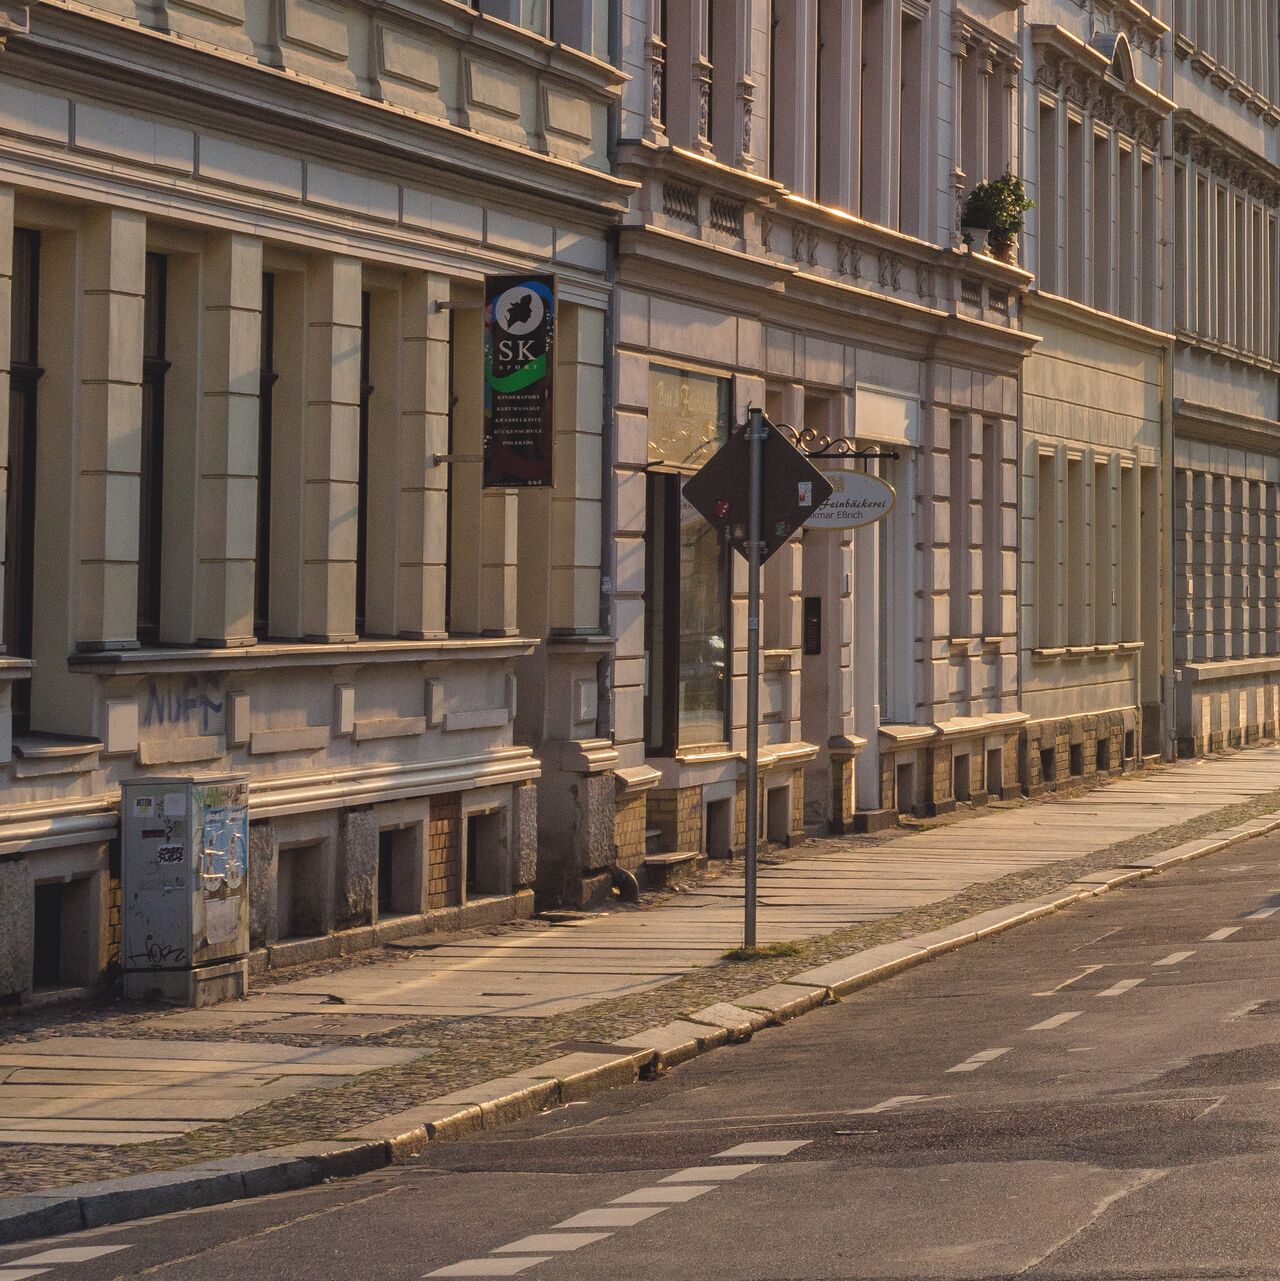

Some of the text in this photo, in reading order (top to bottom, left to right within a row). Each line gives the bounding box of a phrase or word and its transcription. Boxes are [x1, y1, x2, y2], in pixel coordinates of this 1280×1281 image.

[499, 340, 537, 361] SK
[820, 498, 886, 511] Feinbäckerei
[836, 510, 863, 519] Eßrich
